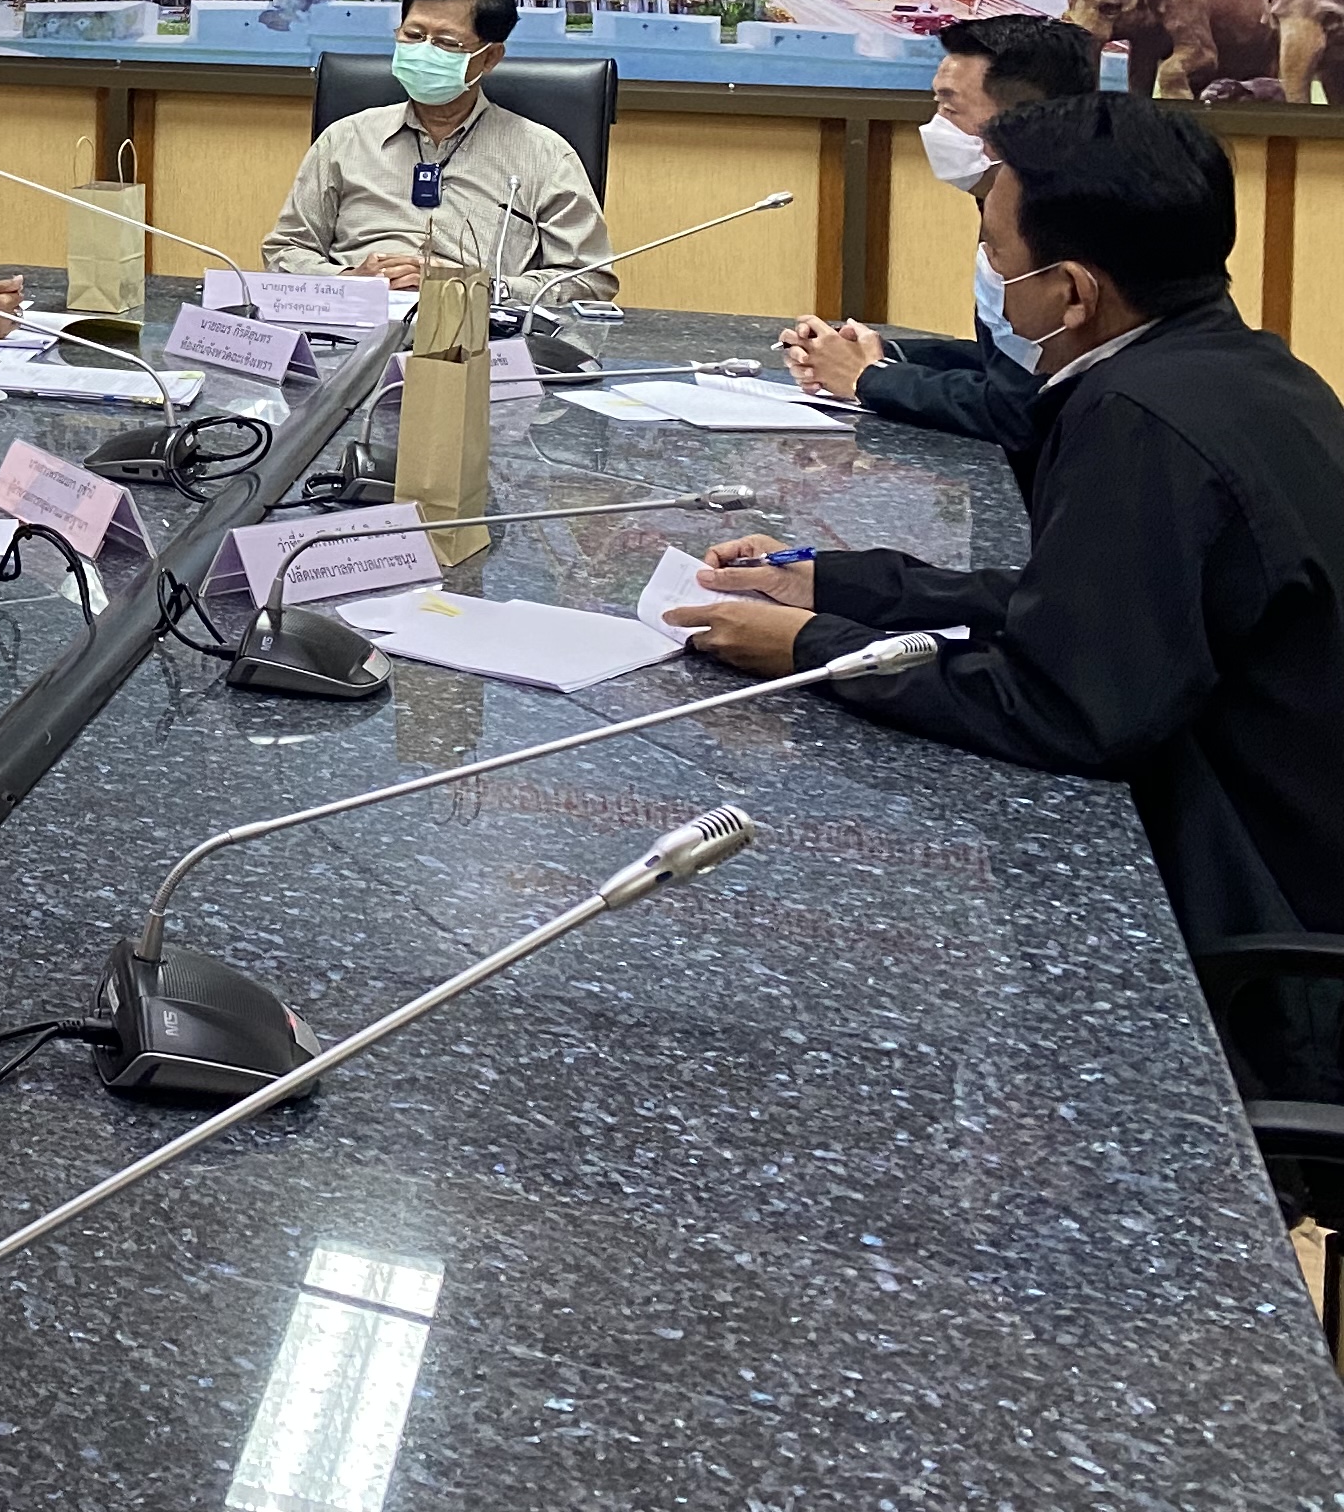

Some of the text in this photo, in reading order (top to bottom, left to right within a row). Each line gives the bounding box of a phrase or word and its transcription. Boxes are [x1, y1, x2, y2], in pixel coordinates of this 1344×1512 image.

[287, 552, 418, 584] ปลัดเทศบาลตำบลเกาะขนุน
